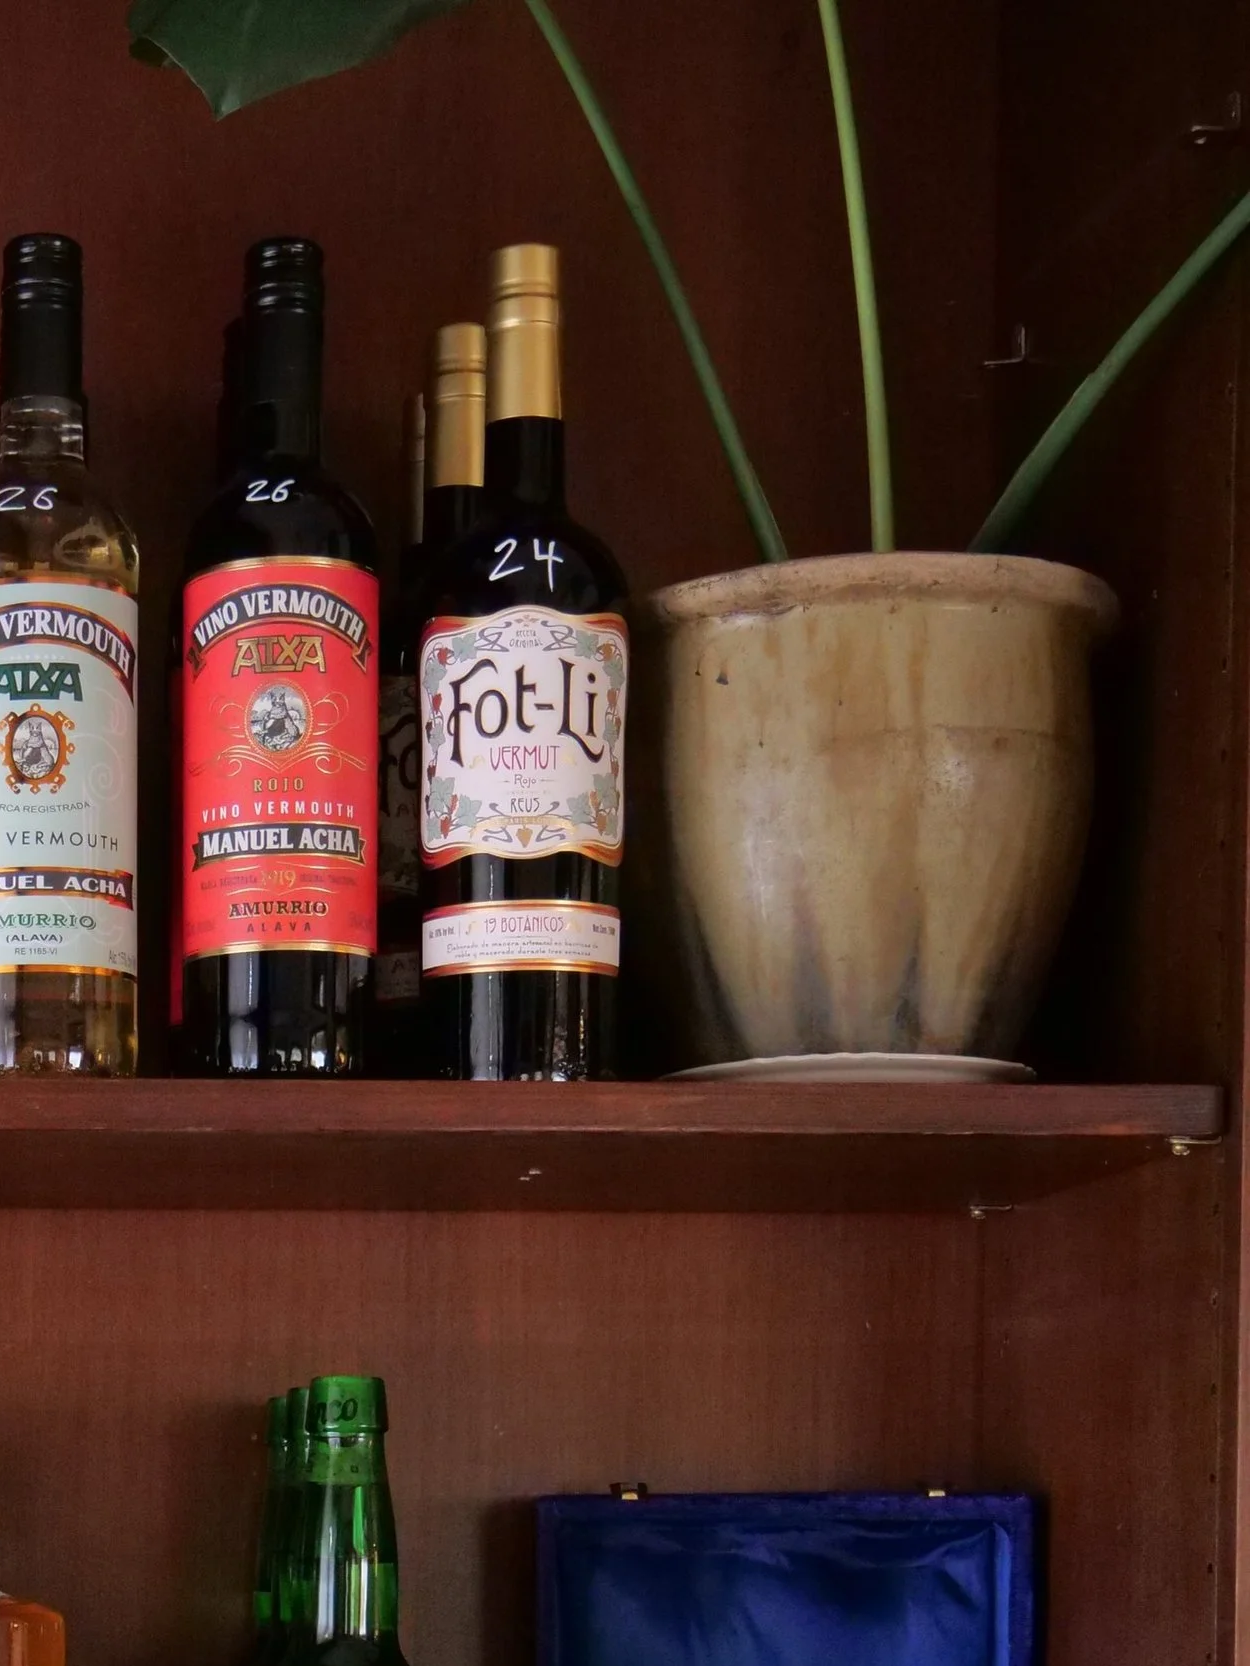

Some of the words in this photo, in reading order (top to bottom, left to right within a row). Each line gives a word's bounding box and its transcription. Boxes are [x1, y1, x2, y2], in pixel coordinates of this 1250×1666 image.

[246, 479, 296, 503] 26
[488, 538, 564, 592] 24
[194, 601, 238, 648] VINO
[241, 589, 365, 644] VERMOUTH
[231, 635, 326, 677] AIXA
[447, 657, 605, 768] Fot-Li
[489, 745, 560, 771] VERMUT
[253, 777, 305, 793] ROJO
[514, 773, 537, 788] Rojo
[23, 801, 91, 814] REGISTRADA
[202, 803, 240, 824] VINO
[254, 800, 354, 819] VERMOUTH
[510, 797, 540, 813] REUS
[6, 830, 119, 853] VERMOUTH
[202, 828, 294, 858] MANUEL
[298, 828, 356, 854] ACHA
[64, 875, 126, 898] ACHA
[228, 900, 329, 919] AMURRIO
[247, 921, 312, 932] ALAVA
[484, 917, 497, 933] 19
[501, 914, 565, 933] BOTÁNICOS
[5, 933, 64, 944] (ALAVA)
